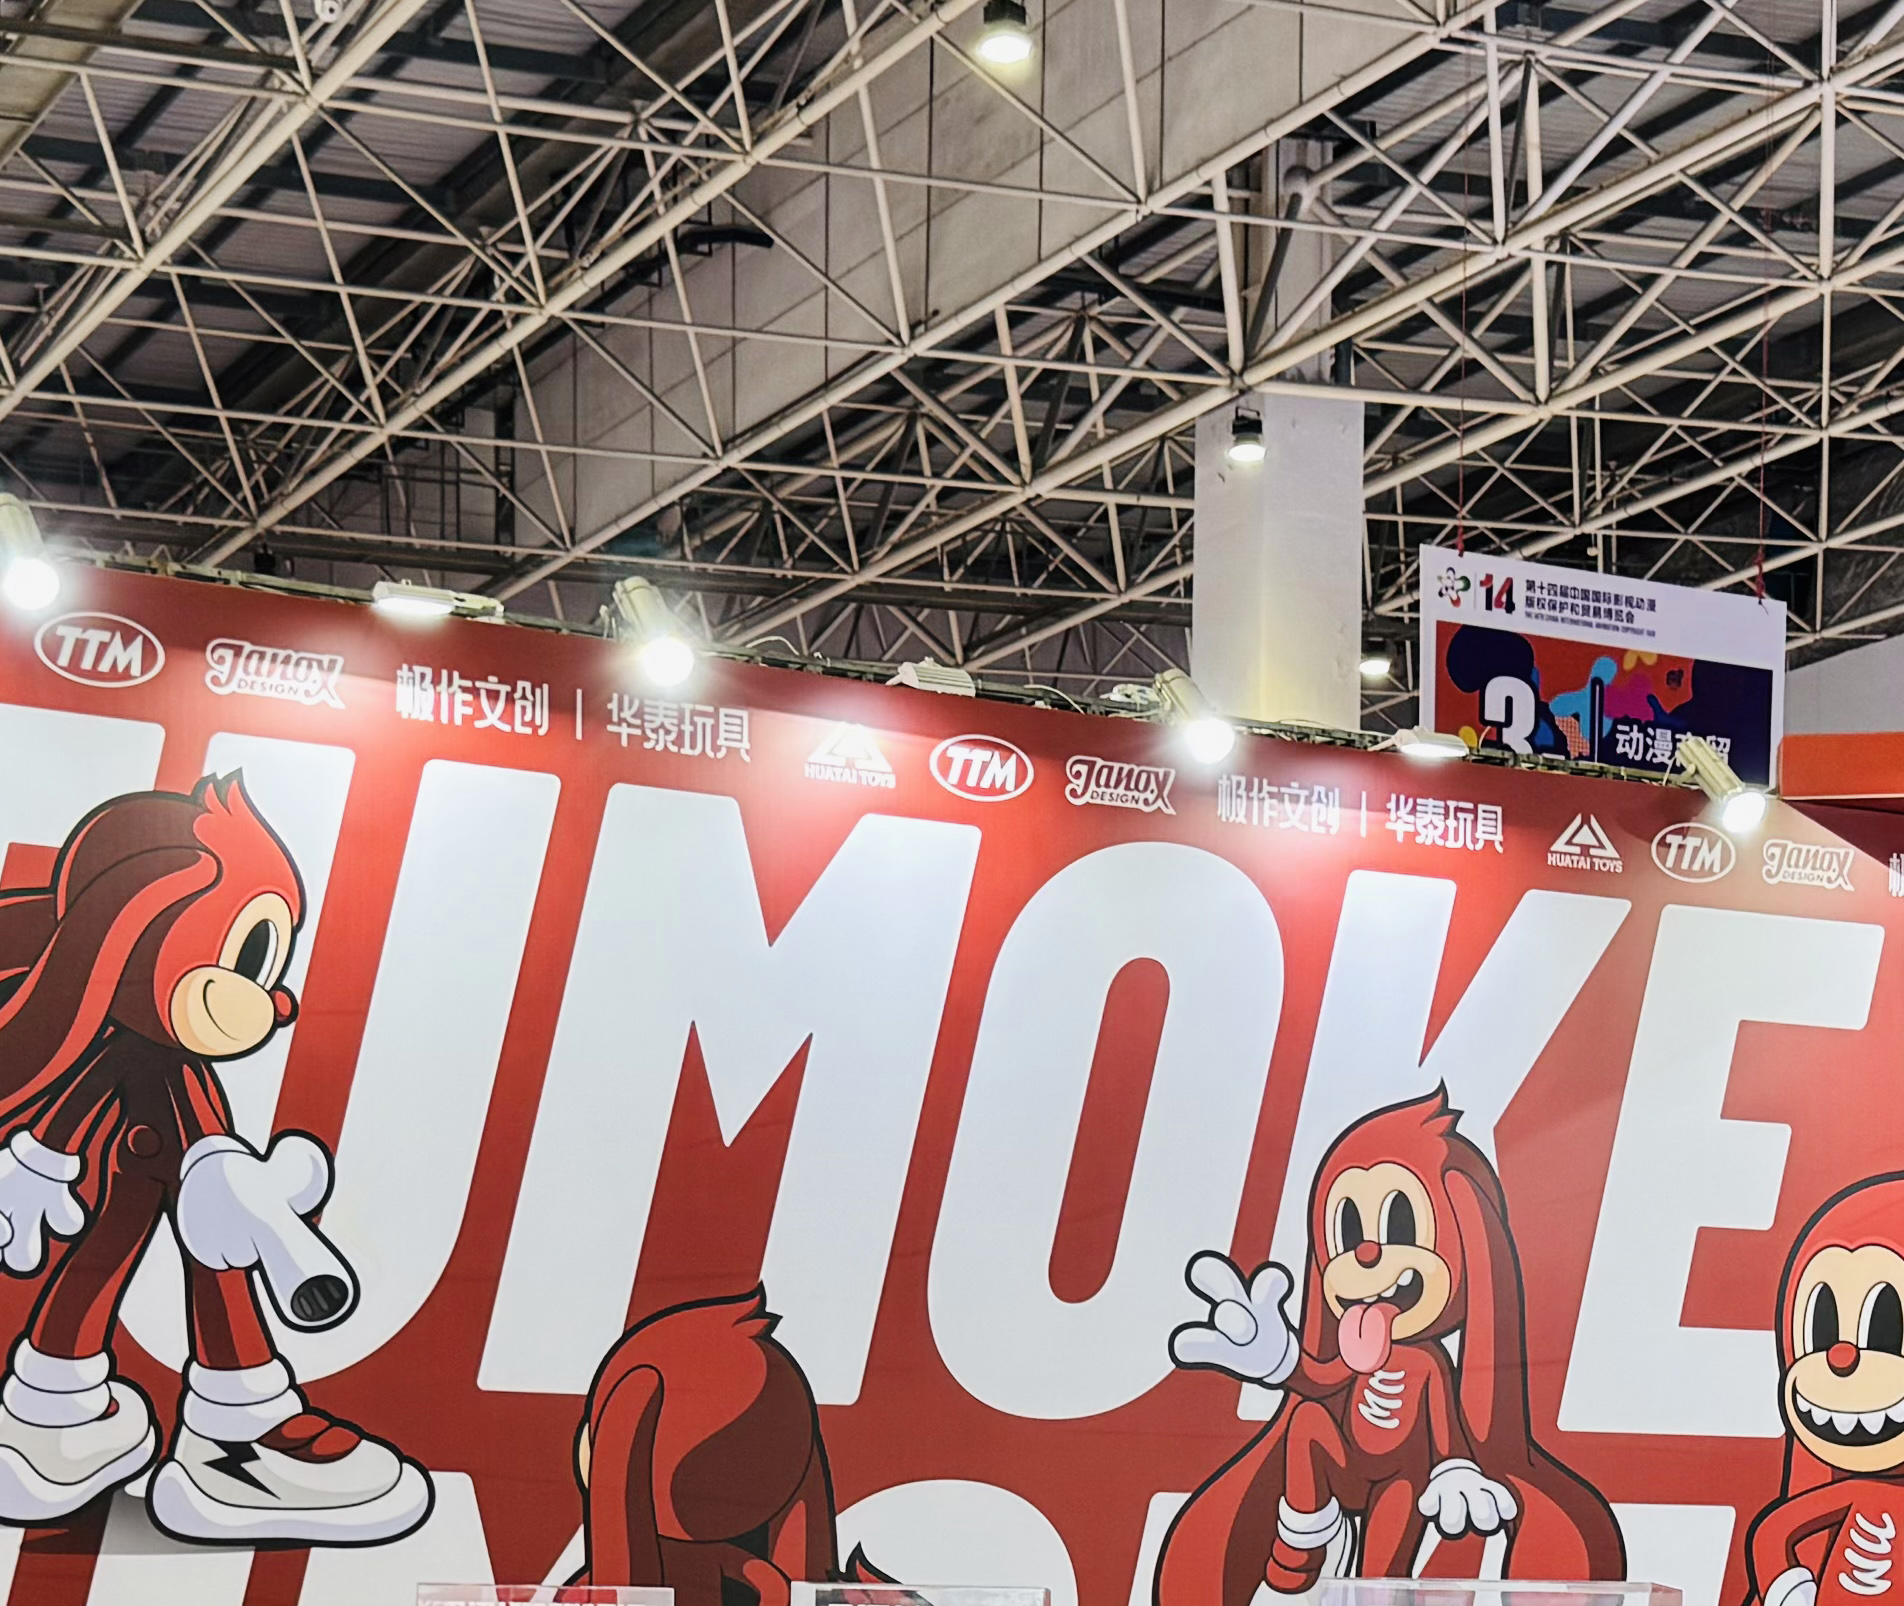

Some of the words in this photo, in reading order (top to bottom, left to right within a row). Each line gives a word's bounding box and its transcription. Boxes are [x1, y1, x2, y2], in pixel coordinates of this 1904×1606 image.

[1480, 573, 1516, 614] 14
[53, 623, 145, 678] TTM
[237, 678, 299, 697] DESIGN
[395, 664, 550, 736] 极作文创
[606, 693, 752, 764] 华泰玩具
[804, 763, 855, 785] HUATAI
[856, 769, 896, 789] TOYS
[946, 749, 1018, 791] TTM
[1090, 790, 1141, 805] DESIGN
[1217, 773, 1341, 836] 极作文创
[1385, 793, 1505, 855] 华泰玩具
[1547, 853, 1592, 870] HUATAI
[1593, 857, 1624, 873] TOYS
[1663, 837, 1724, 874] TTM
[1782, 870, 1826, 884] DESIGN
